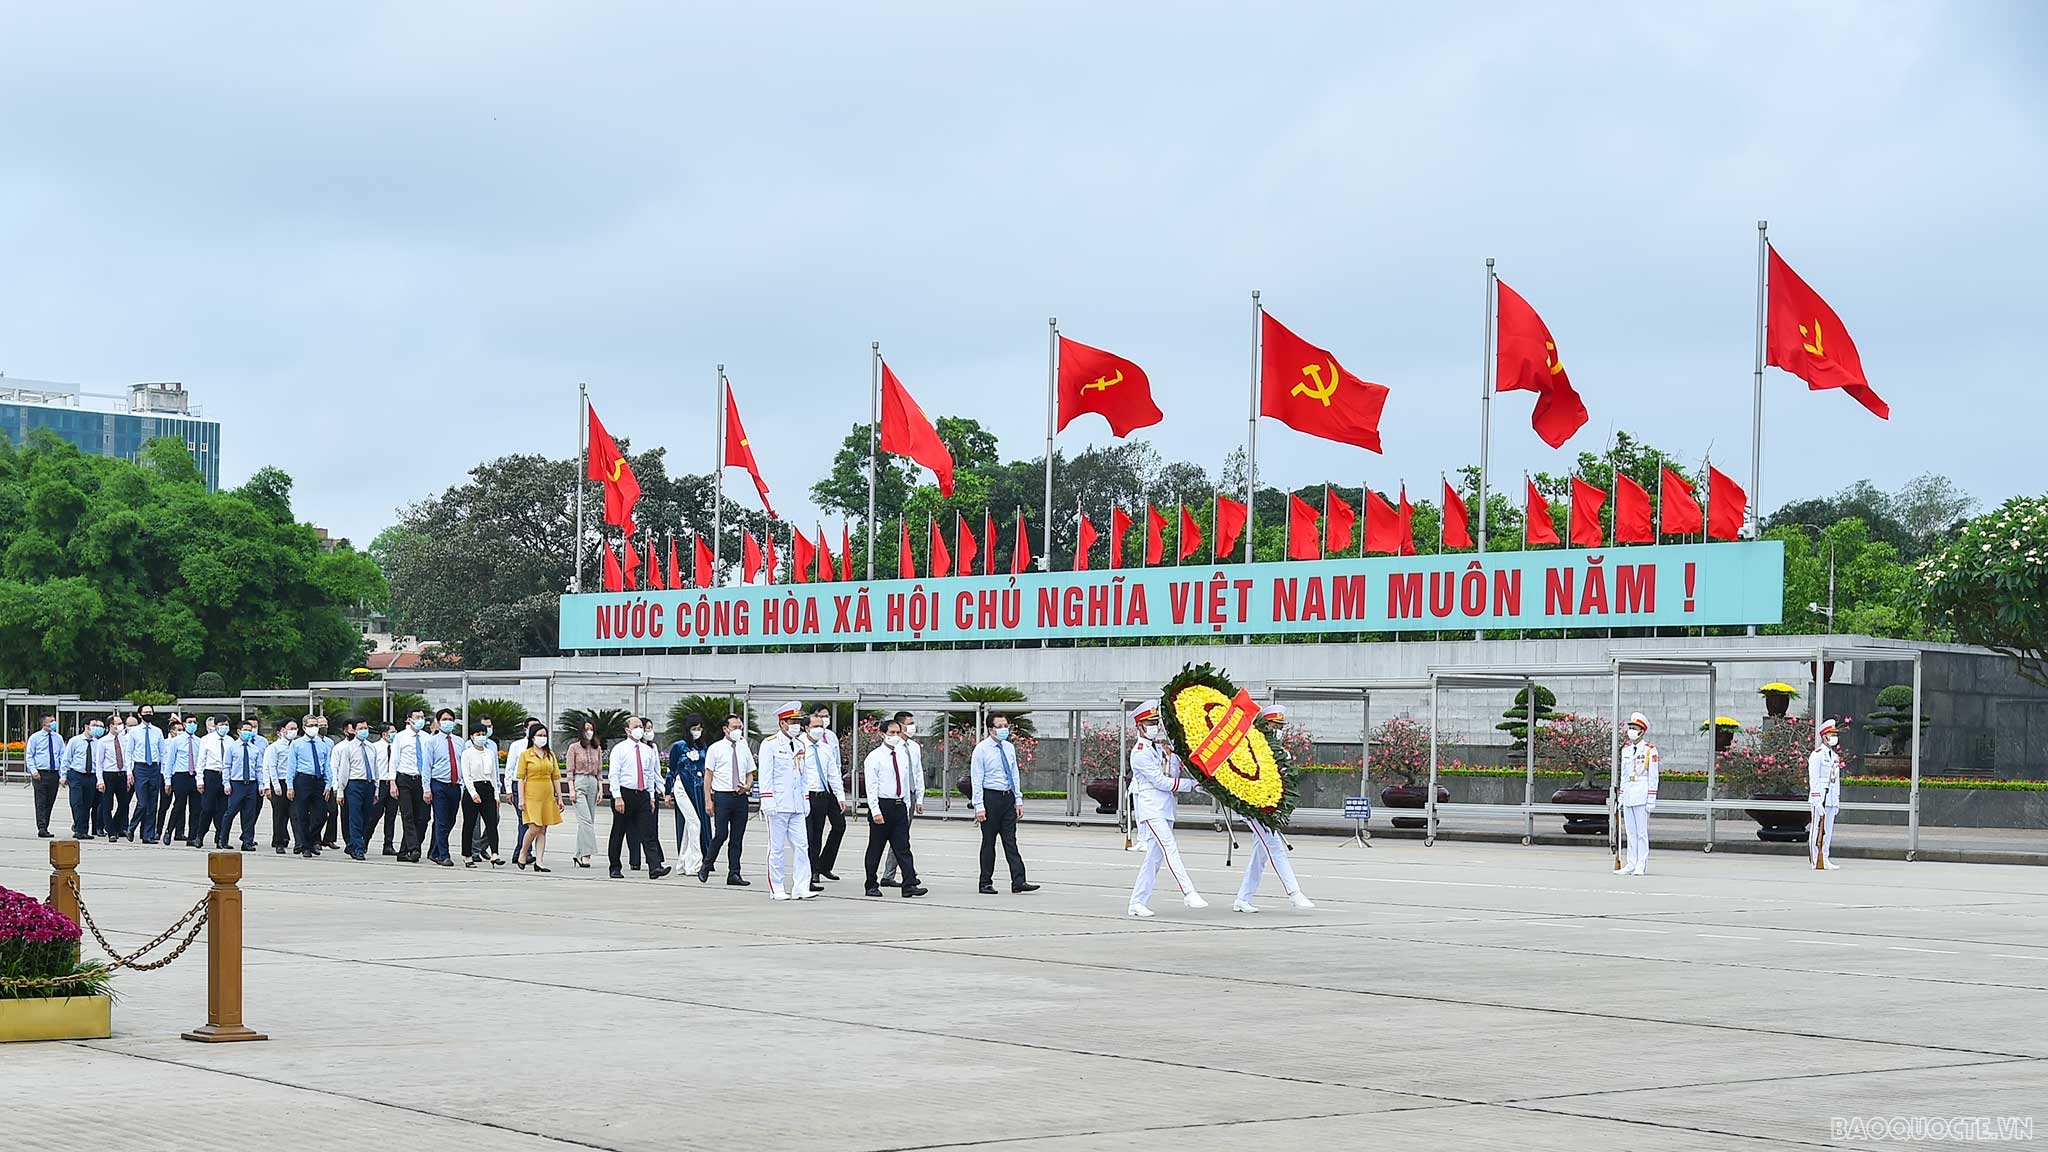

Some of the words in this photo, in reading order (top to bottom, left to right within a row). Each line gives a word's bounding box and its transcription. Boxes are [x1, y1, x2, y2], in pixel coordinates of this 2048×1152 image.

[596, 597, 663, 639] NƯỚC
[676, 594, 749, 643] CỘNG
[763, 590, 820, 635] HÒA
[833, 587, 872, 633] XÃ
[887, 584, 940, 638] HỘI
[955, 576, 1021, 630] CHỦ
[1037, 576, 1149, 627] NGHĨA
[1169, 572, 1253, 632] VIỆT
[1272, 575, 1366, 621] NAM
[1387, 560, 1522, 619] MUÔN
[1545, 555, 1657, 616] NĂM
